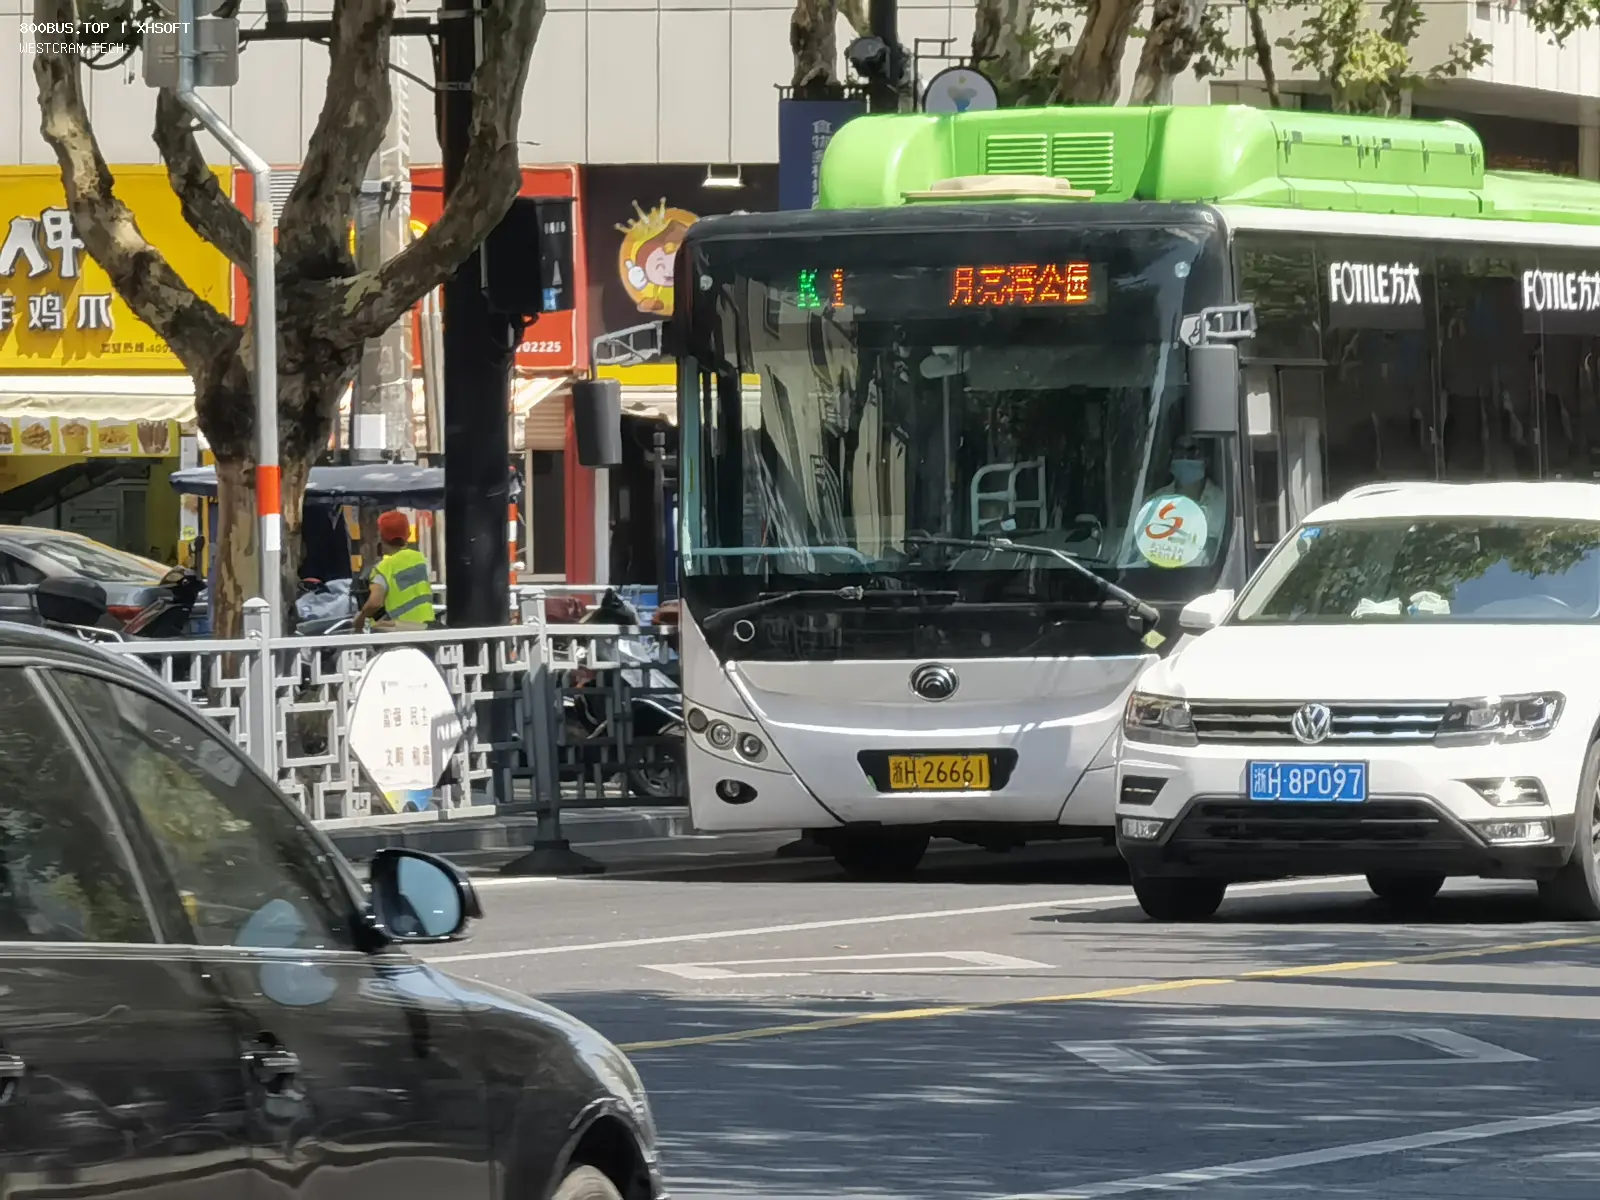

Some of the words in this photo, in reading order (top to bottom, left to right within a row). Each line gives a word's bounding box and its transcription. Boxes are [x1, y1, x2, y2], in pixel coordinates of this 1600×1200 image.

[948, 263, 1089, 305] 月亮湾公园
